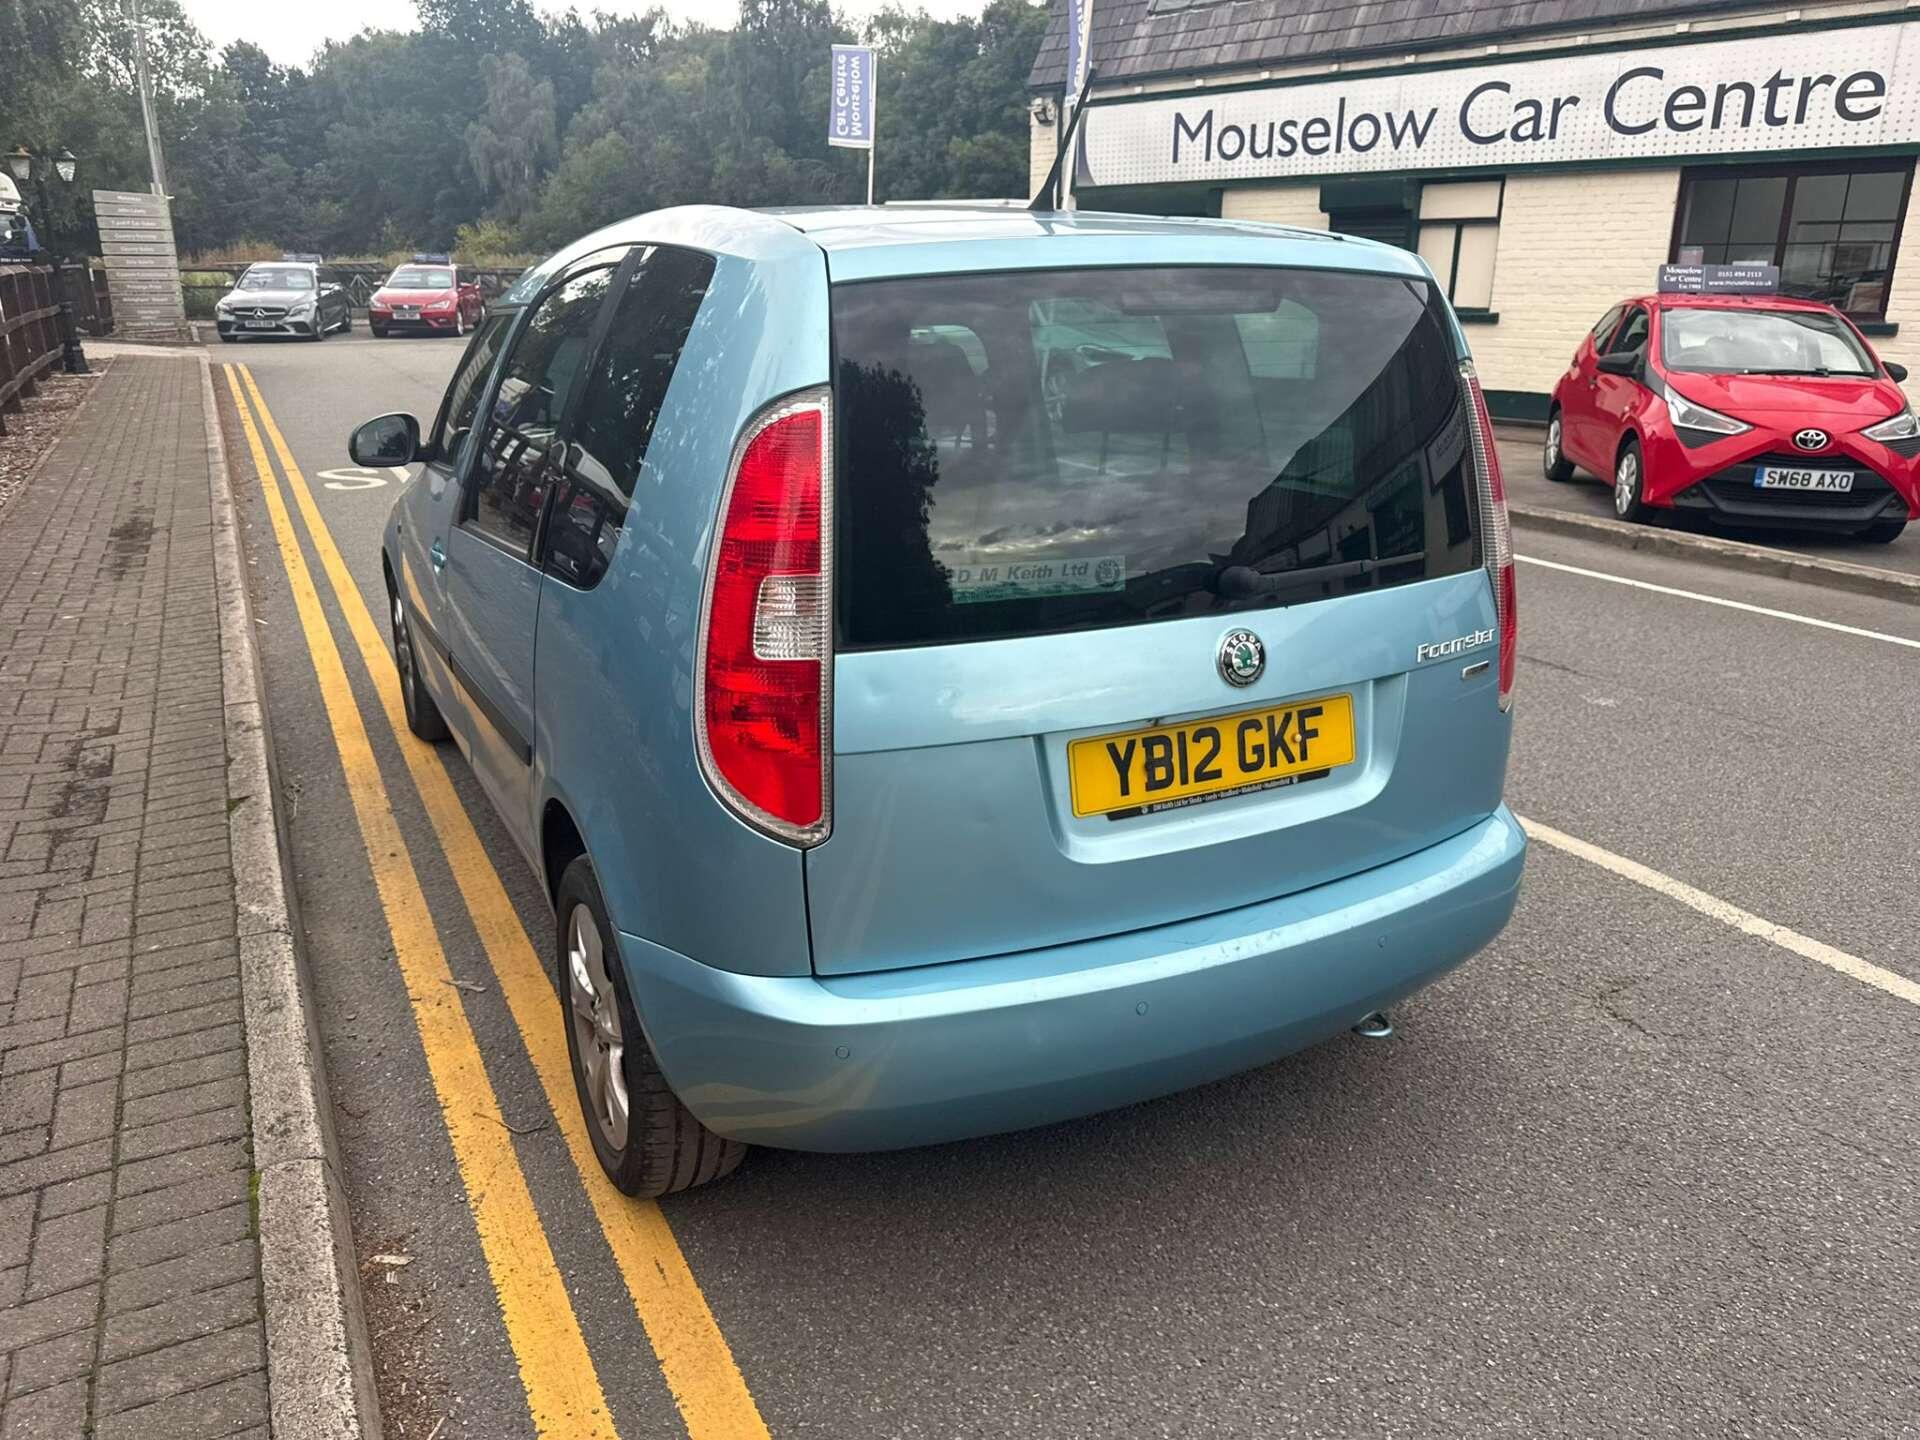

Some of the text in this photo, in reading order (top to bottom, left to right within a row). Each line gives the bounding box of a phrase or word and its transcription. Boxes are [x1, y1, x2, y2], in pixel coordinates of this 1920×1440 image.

[1172, 66, 1887, 164] Mouselow Car Centre
[1663, 274, 1677, 282] Car
[1766, 470, 1812, 487] SW68
[1815, 473, 1851, 489] AXO
[957, 561, 1089, 583] D M Keith Ltd
[1417, 628, 1496, 663] Roomster
[1106, 705, 1324, 797] YB12 GKF
